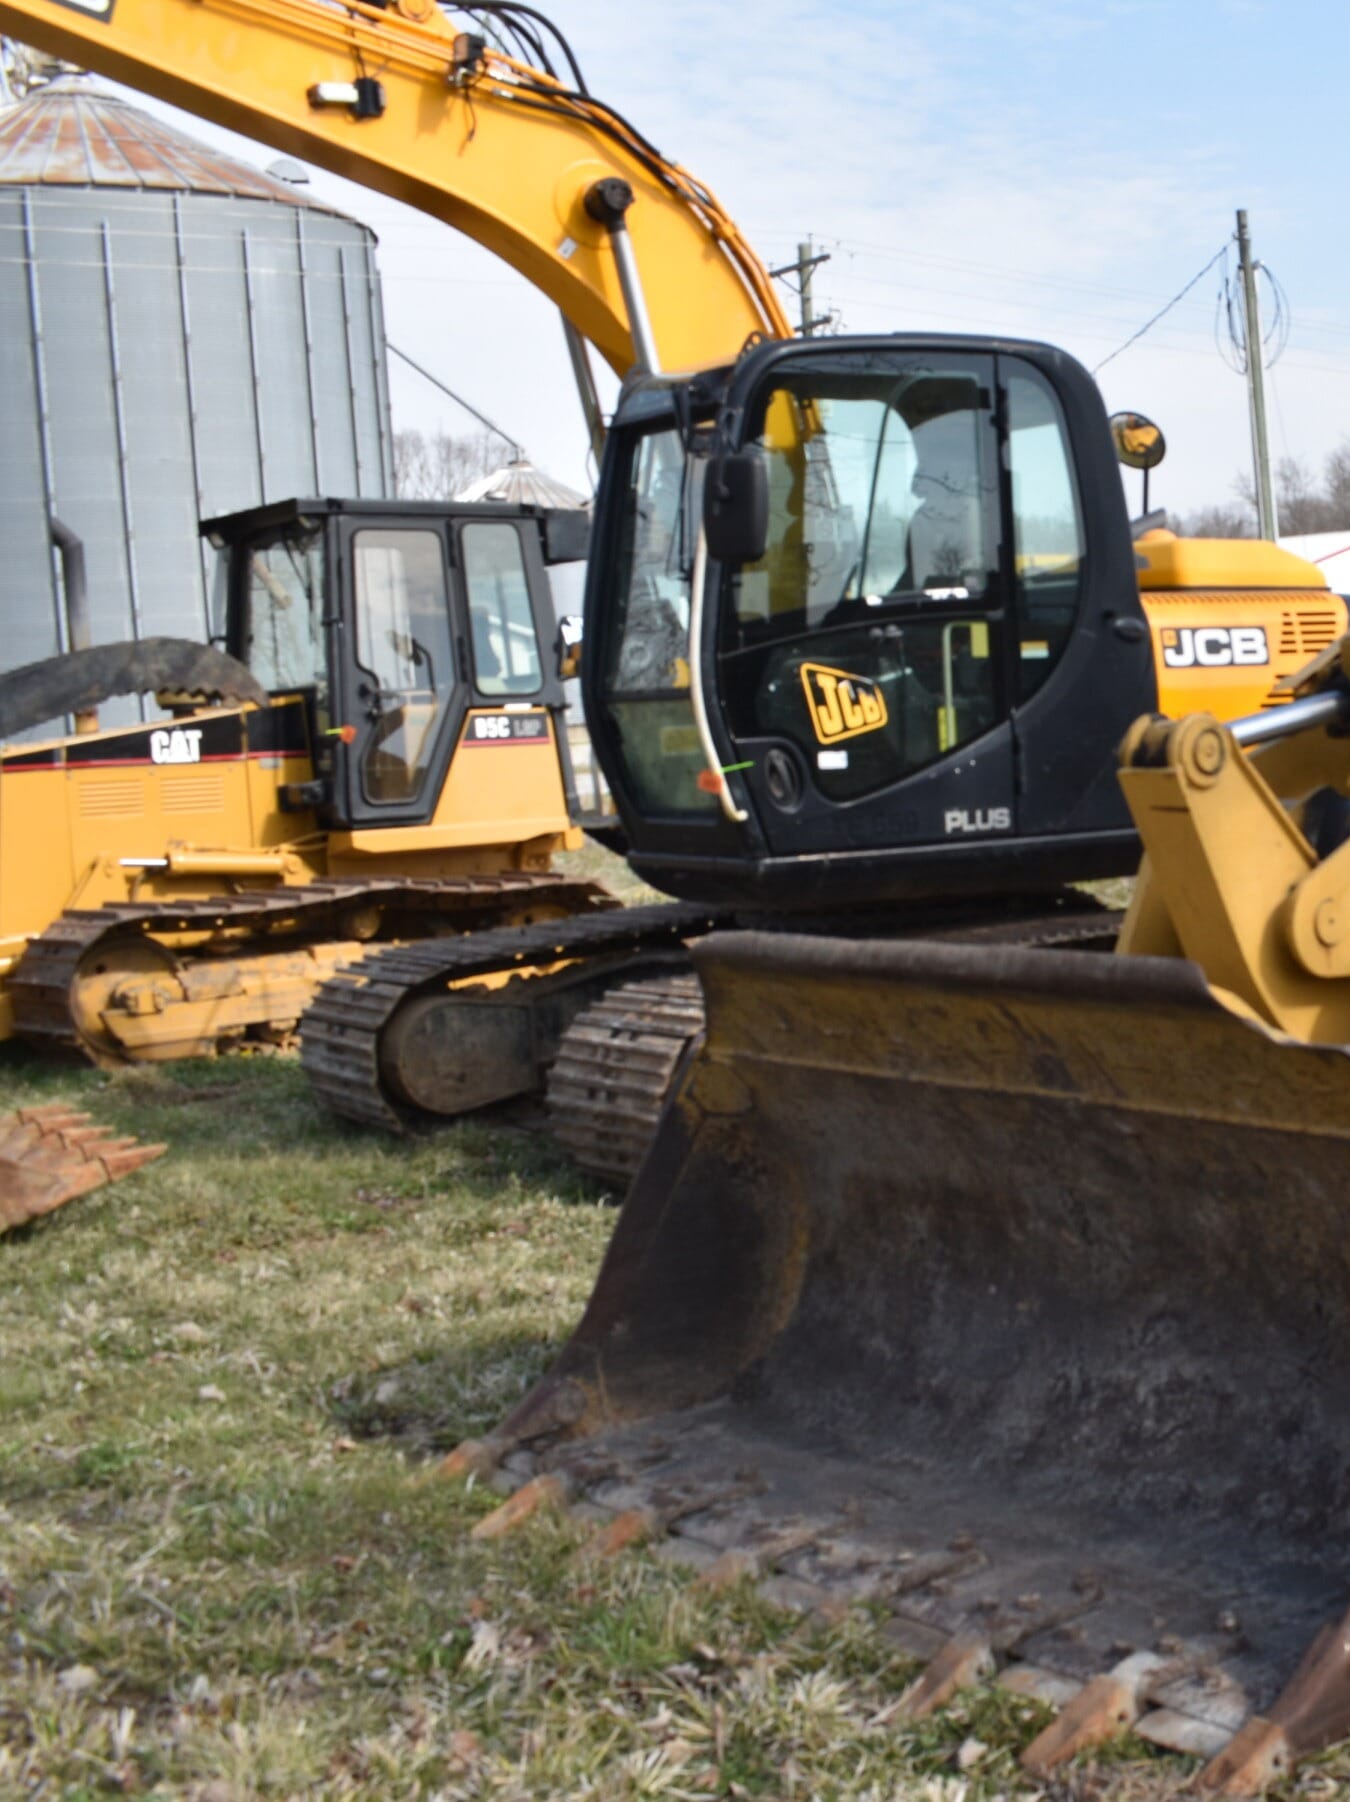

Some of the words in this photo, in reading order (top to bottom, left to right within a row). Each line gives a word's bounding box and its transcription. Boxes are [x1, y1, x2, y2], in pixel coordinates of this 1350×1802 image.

[1163, 628, 1269, 667] JCB
[474, 716, 511, 738] D5C
[150, 729, 203, 764] CAT
[944, 807, 1011, 834] PLUS
